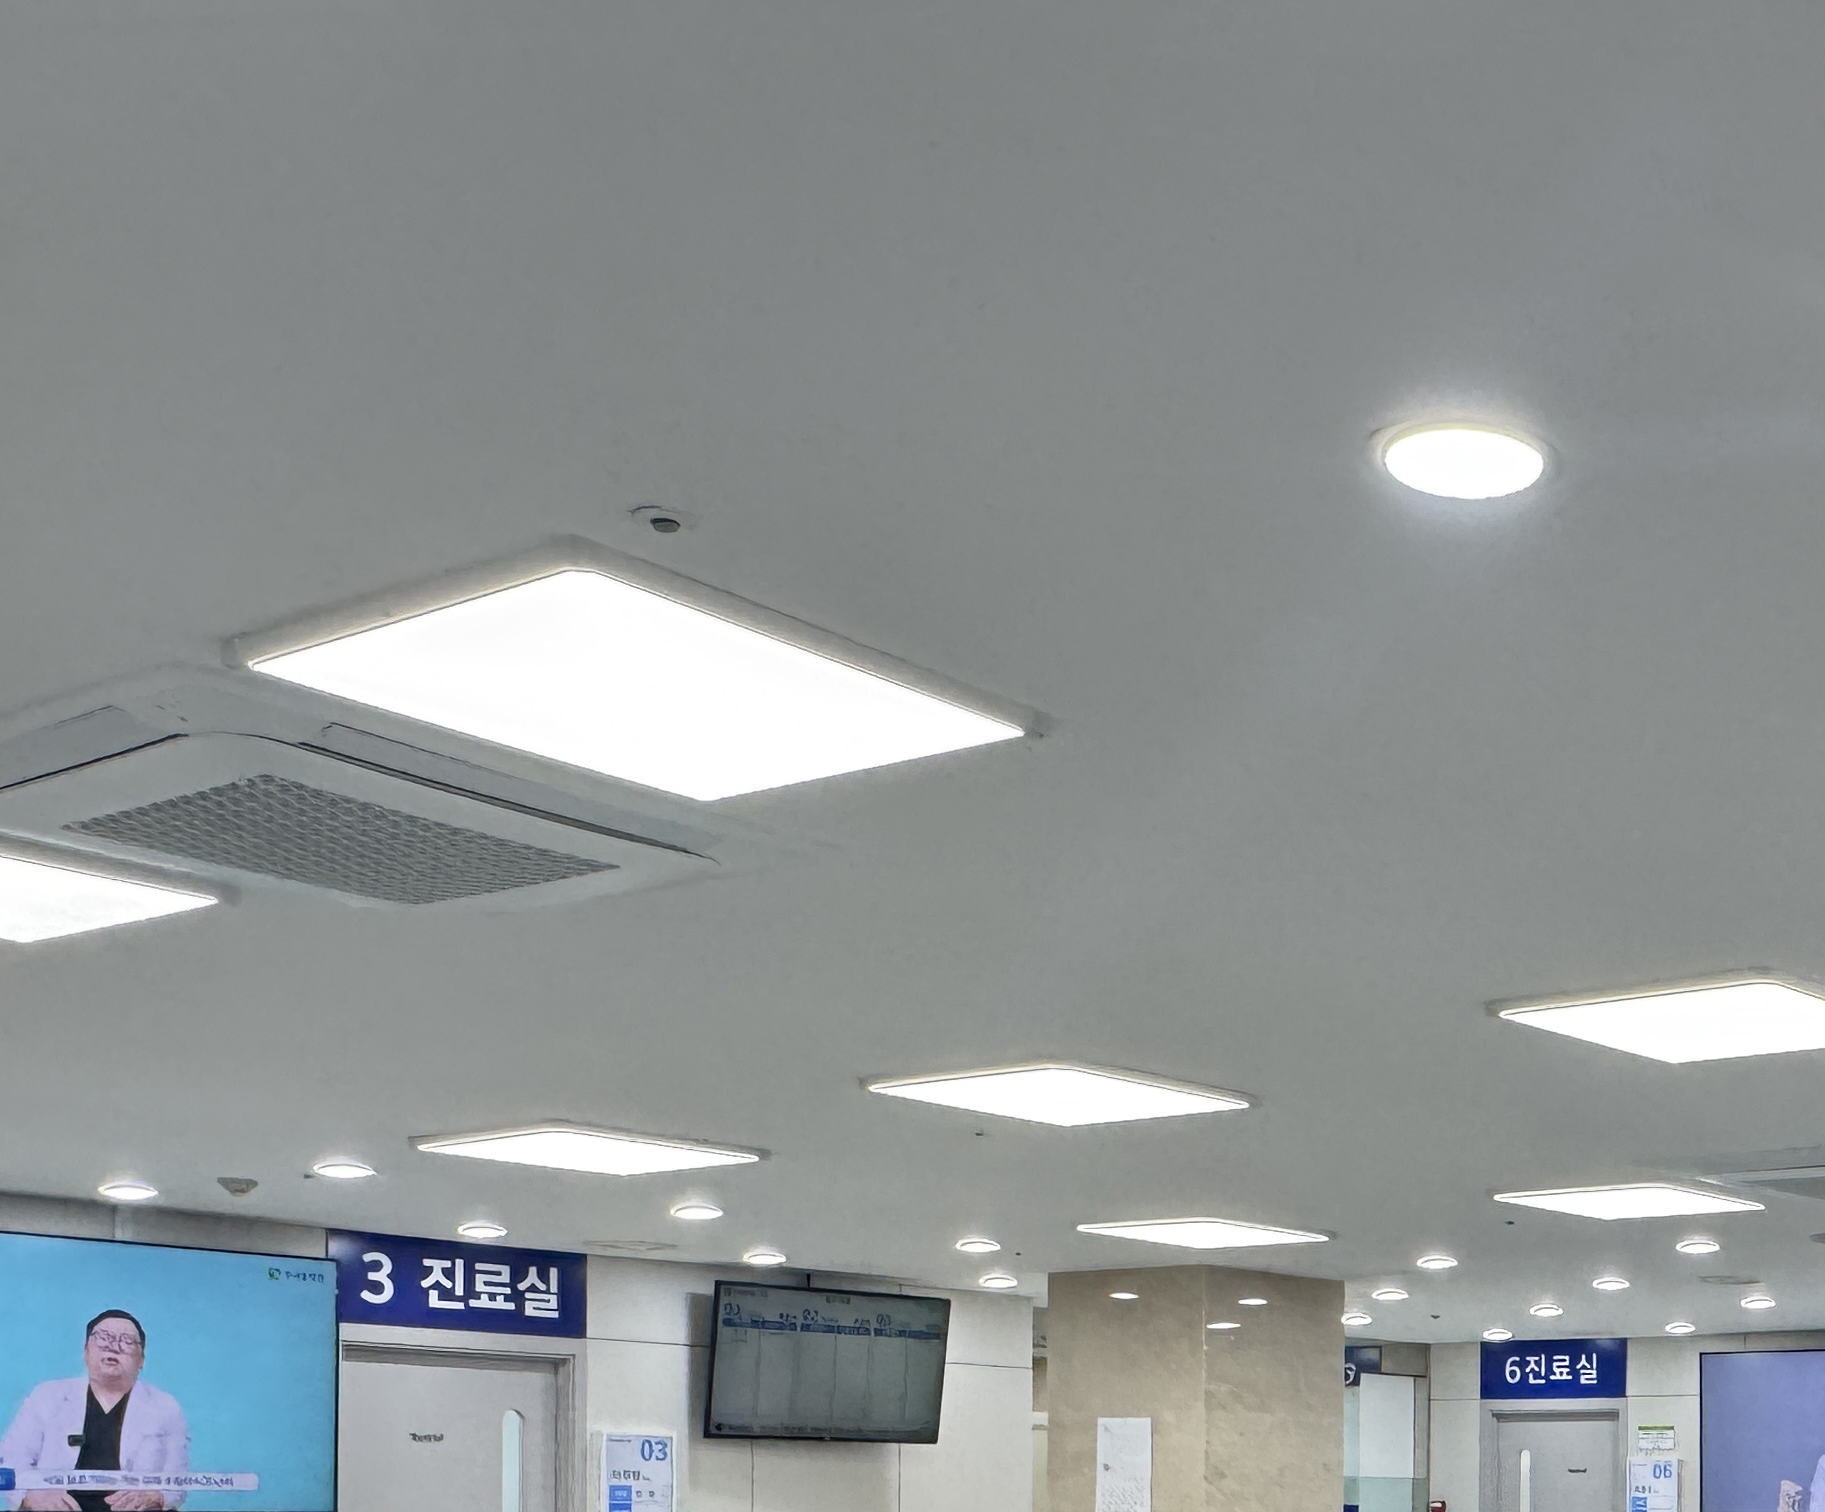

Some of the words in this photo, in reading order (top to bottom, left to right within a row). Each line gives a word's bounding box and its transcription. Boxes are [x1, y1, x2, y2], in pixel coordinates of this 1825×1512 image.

[360, 1252, 395, 1304] 3
[420, 1258, 559, 1319] 진료실
[1505, 1353, 1598, 1385] 6진료실
[640, 1439, 668, 1462] 03
[1652, 1463, 1673, 1479] 06
